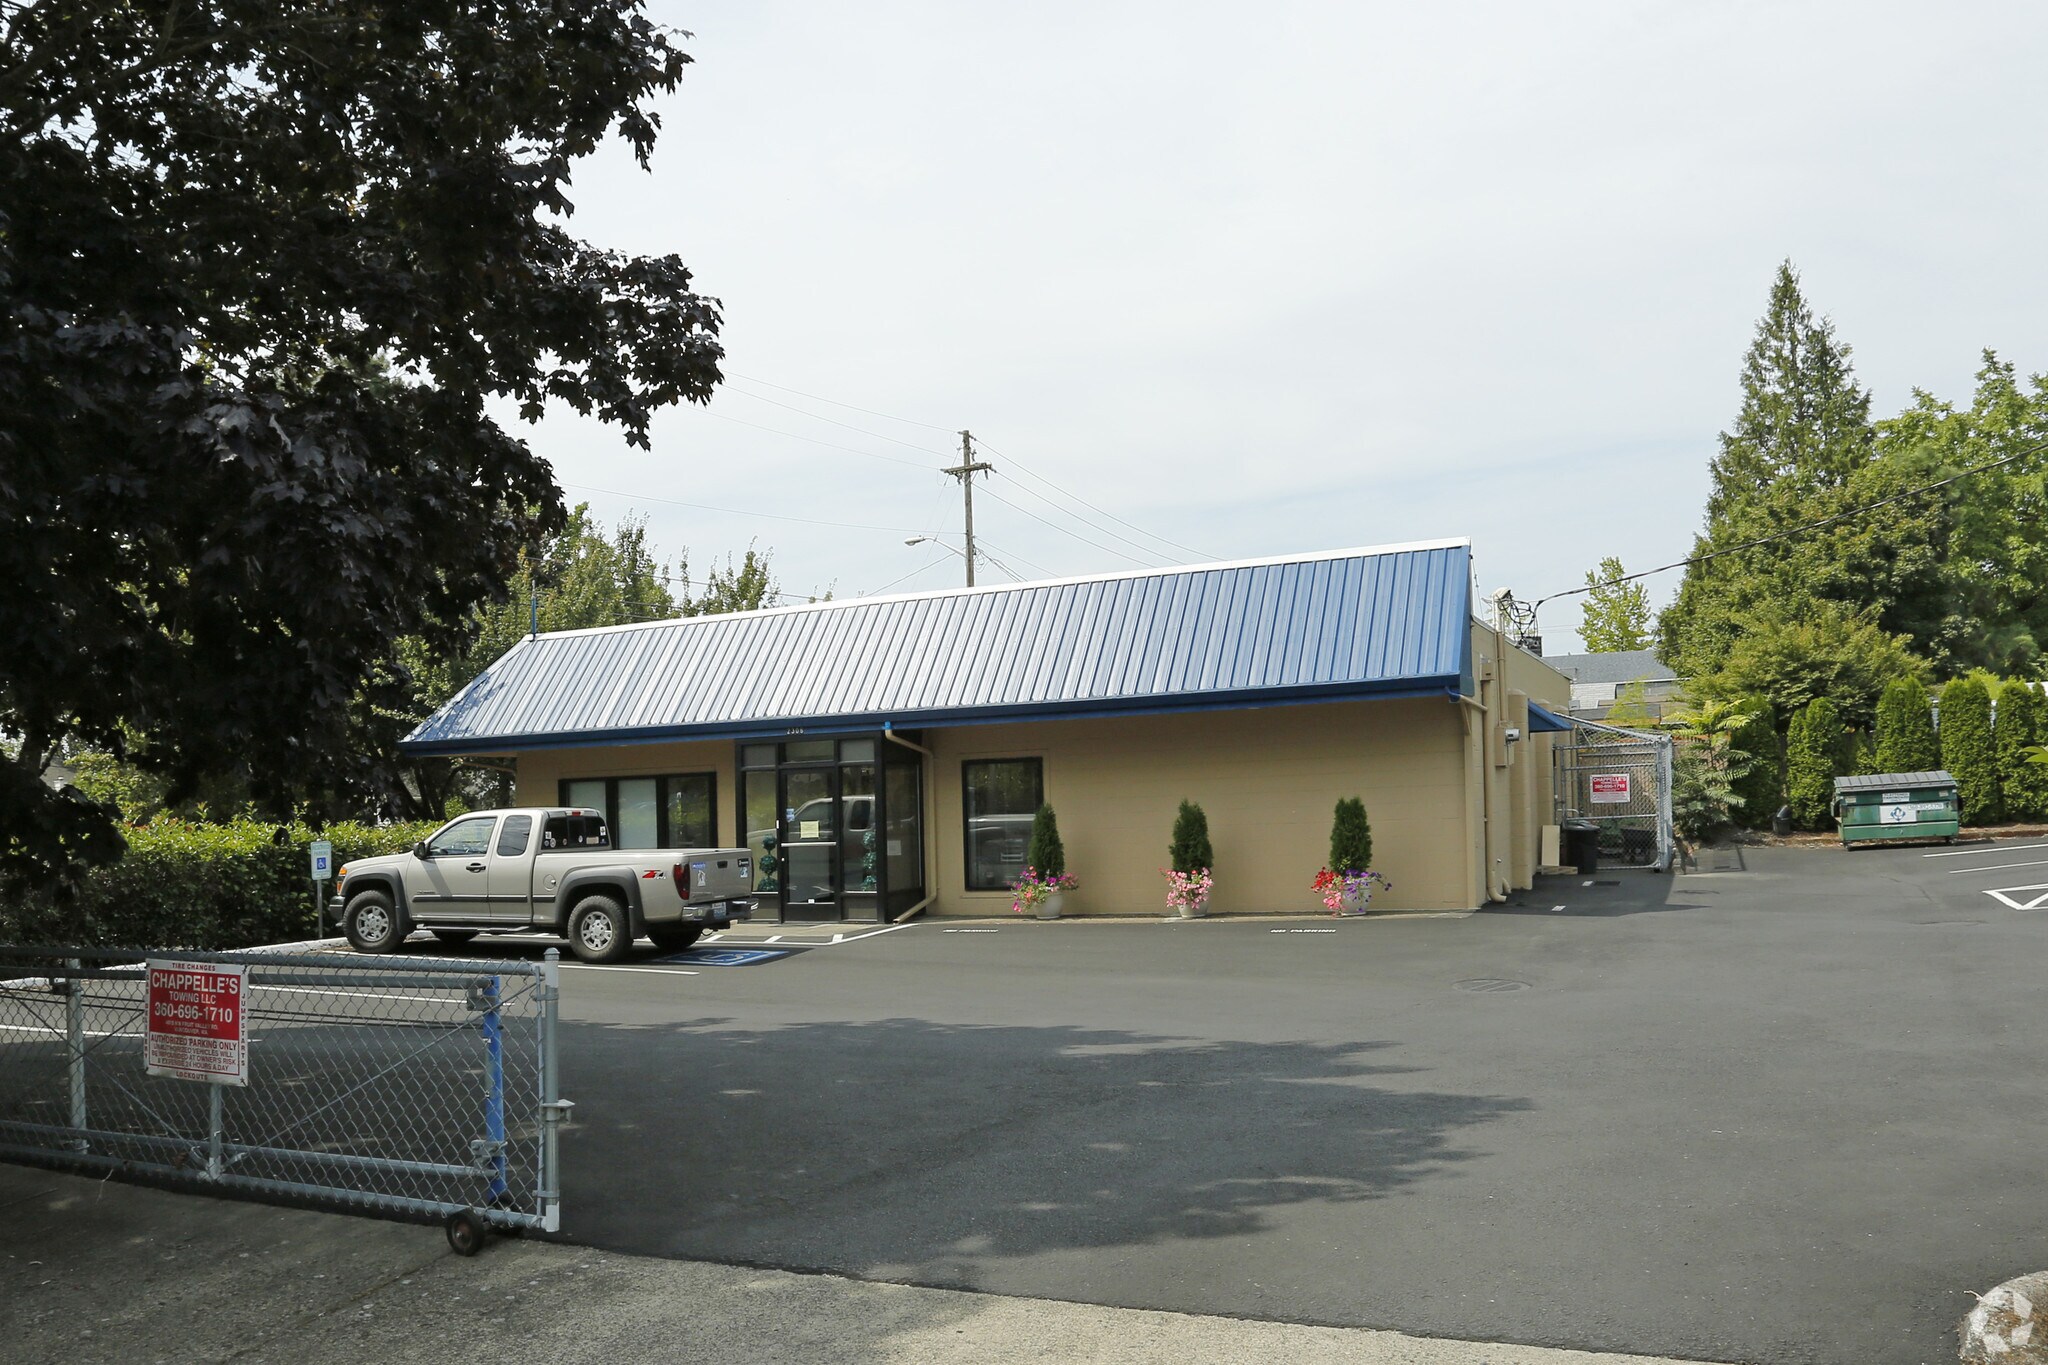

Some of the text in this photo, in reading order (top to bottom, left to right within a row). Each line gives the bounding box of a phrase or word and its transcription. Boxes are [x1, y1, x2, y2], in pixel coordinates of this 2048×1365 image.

[172, 962, 216, 972] TIRE CHANGES
[151, 971, 239, 995] CHAPPELLE'S
[168, 990, 217, 1005] TOWING LLC
[154, 1001, 233, 1023] 360-696-1710
[150, 1033, 238, 1051] AUTHORIZED PARKING ONLY
[153, 1043, 192, 1054] UNAUTHORIZED
[193, 1048, 219, 1057] VEHICLES
[192, 1061, 212, 1070] HOURS
[196, 1055, 222, 1064] OWNER'S
[222, 1058, 237, 1066] RISK
[175, 1071, 209, 1081] LOCKOUTS
